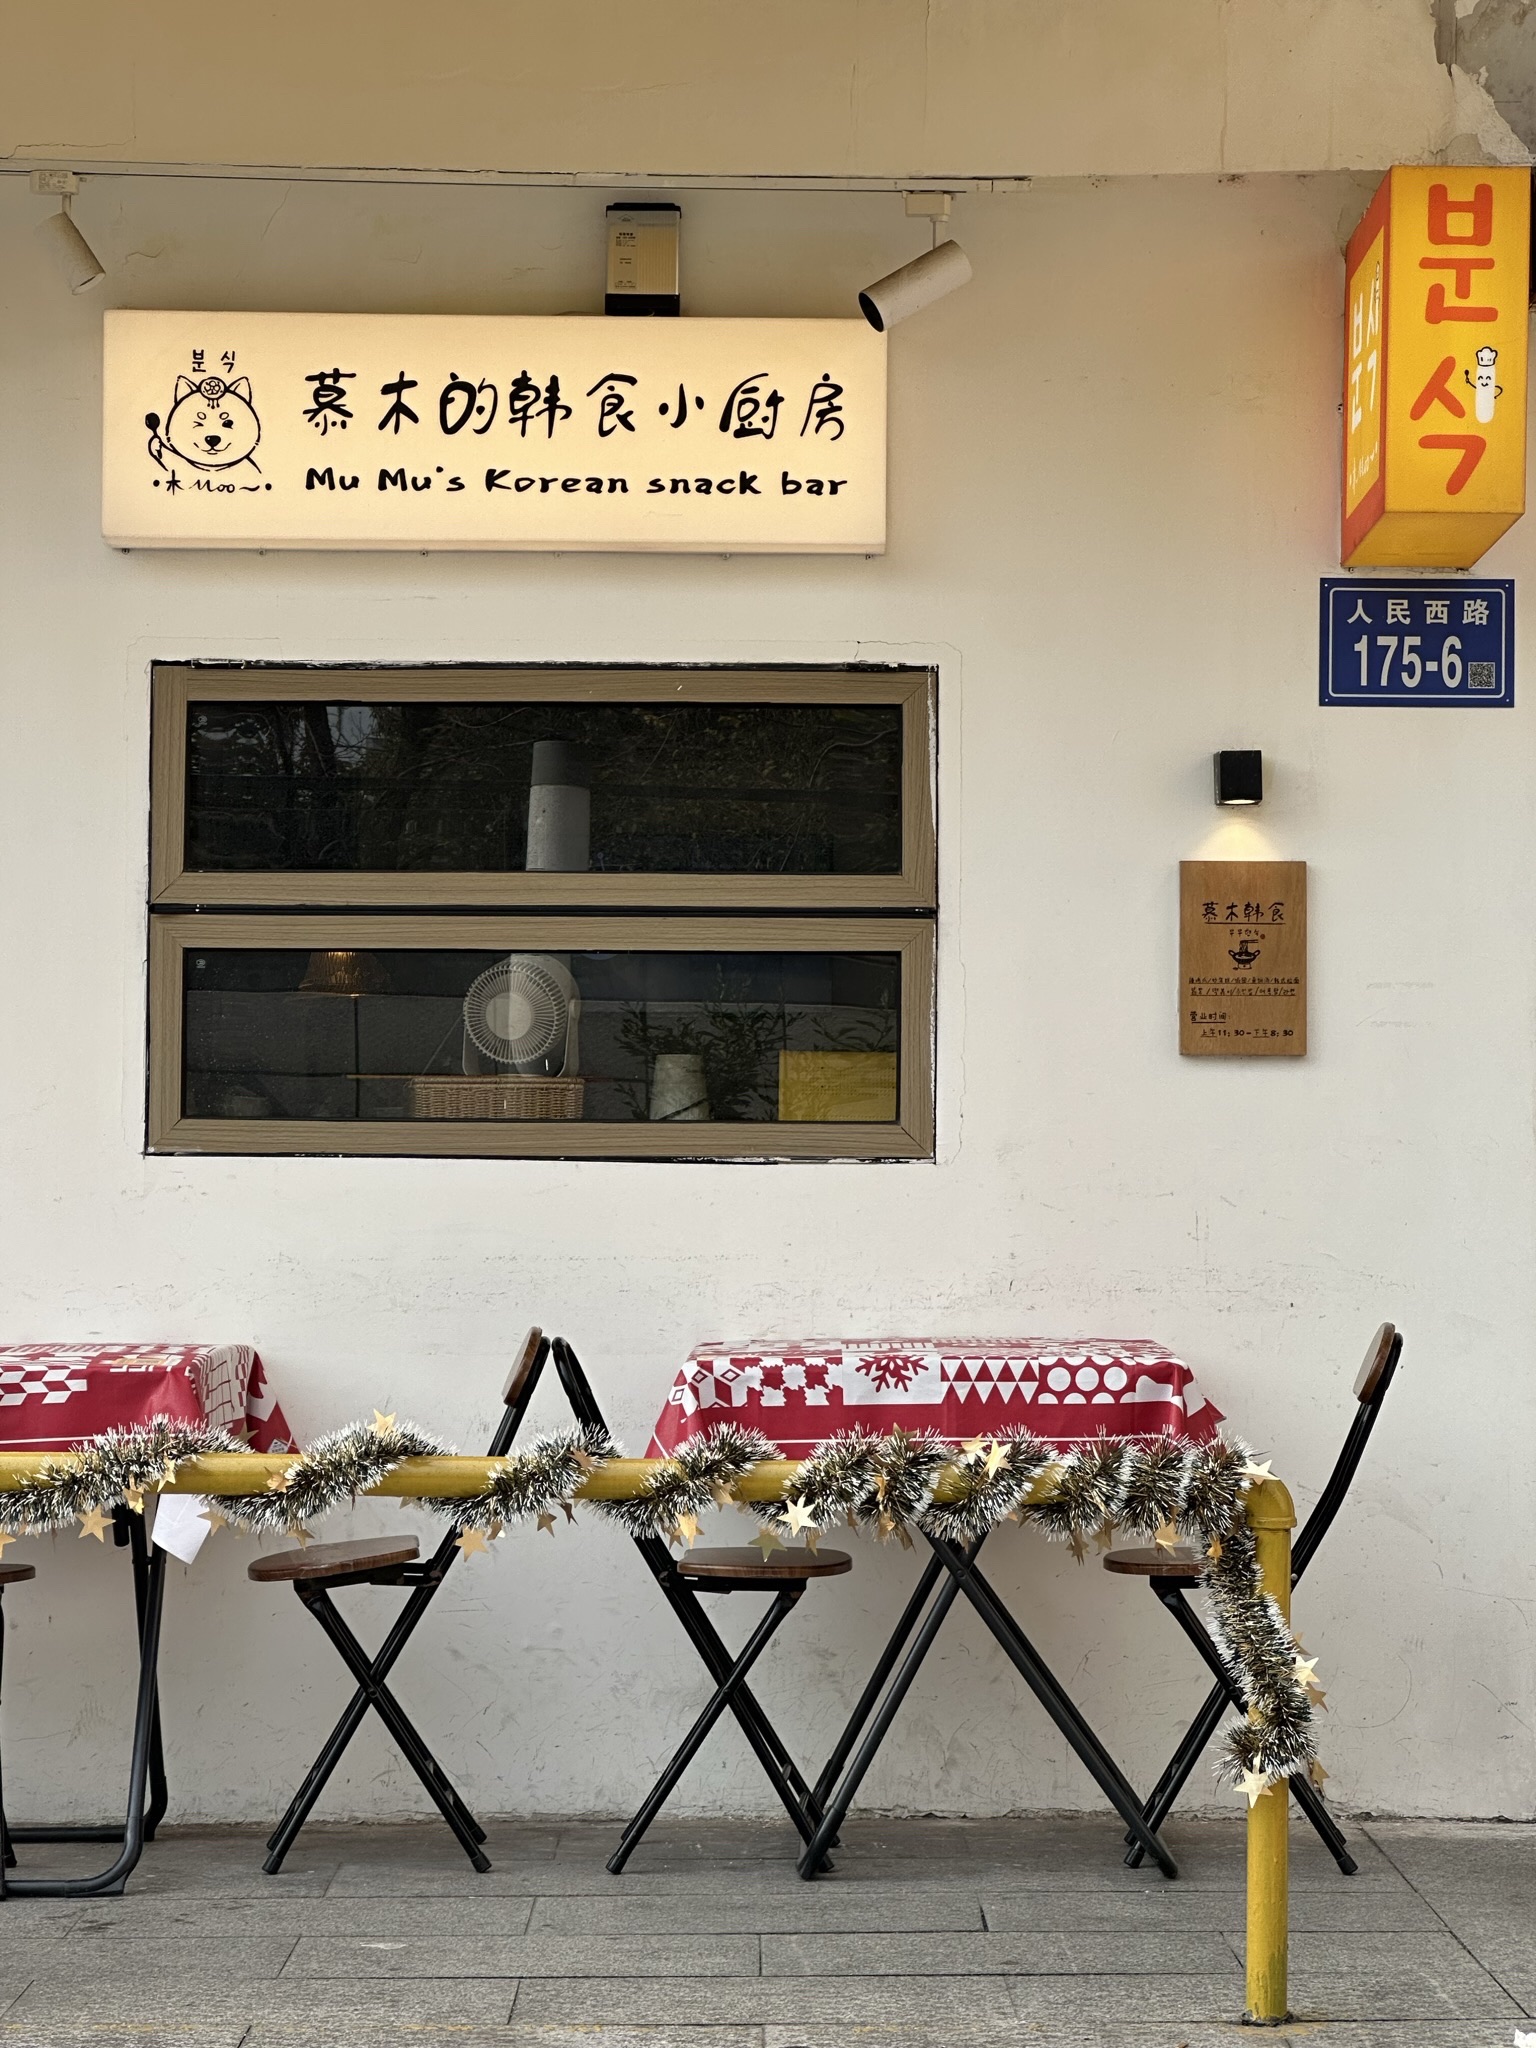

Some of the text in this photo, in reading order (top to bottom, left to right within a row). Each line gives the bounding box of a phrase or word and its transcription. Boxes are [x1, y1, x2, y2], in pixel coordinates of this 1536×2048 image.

[1409, 183, 1500, 496] 분식
[302, 366, 847, 442] 慕木的韩食小厨房
[305, 465, 849, 497] Mu Mu's Korean snack bar
[1346, 599, 1490, 626] 人民西路
[1353, 634, 1463, 688] 175-6
[1202, 901, 1285, 922] 慕木韩食
